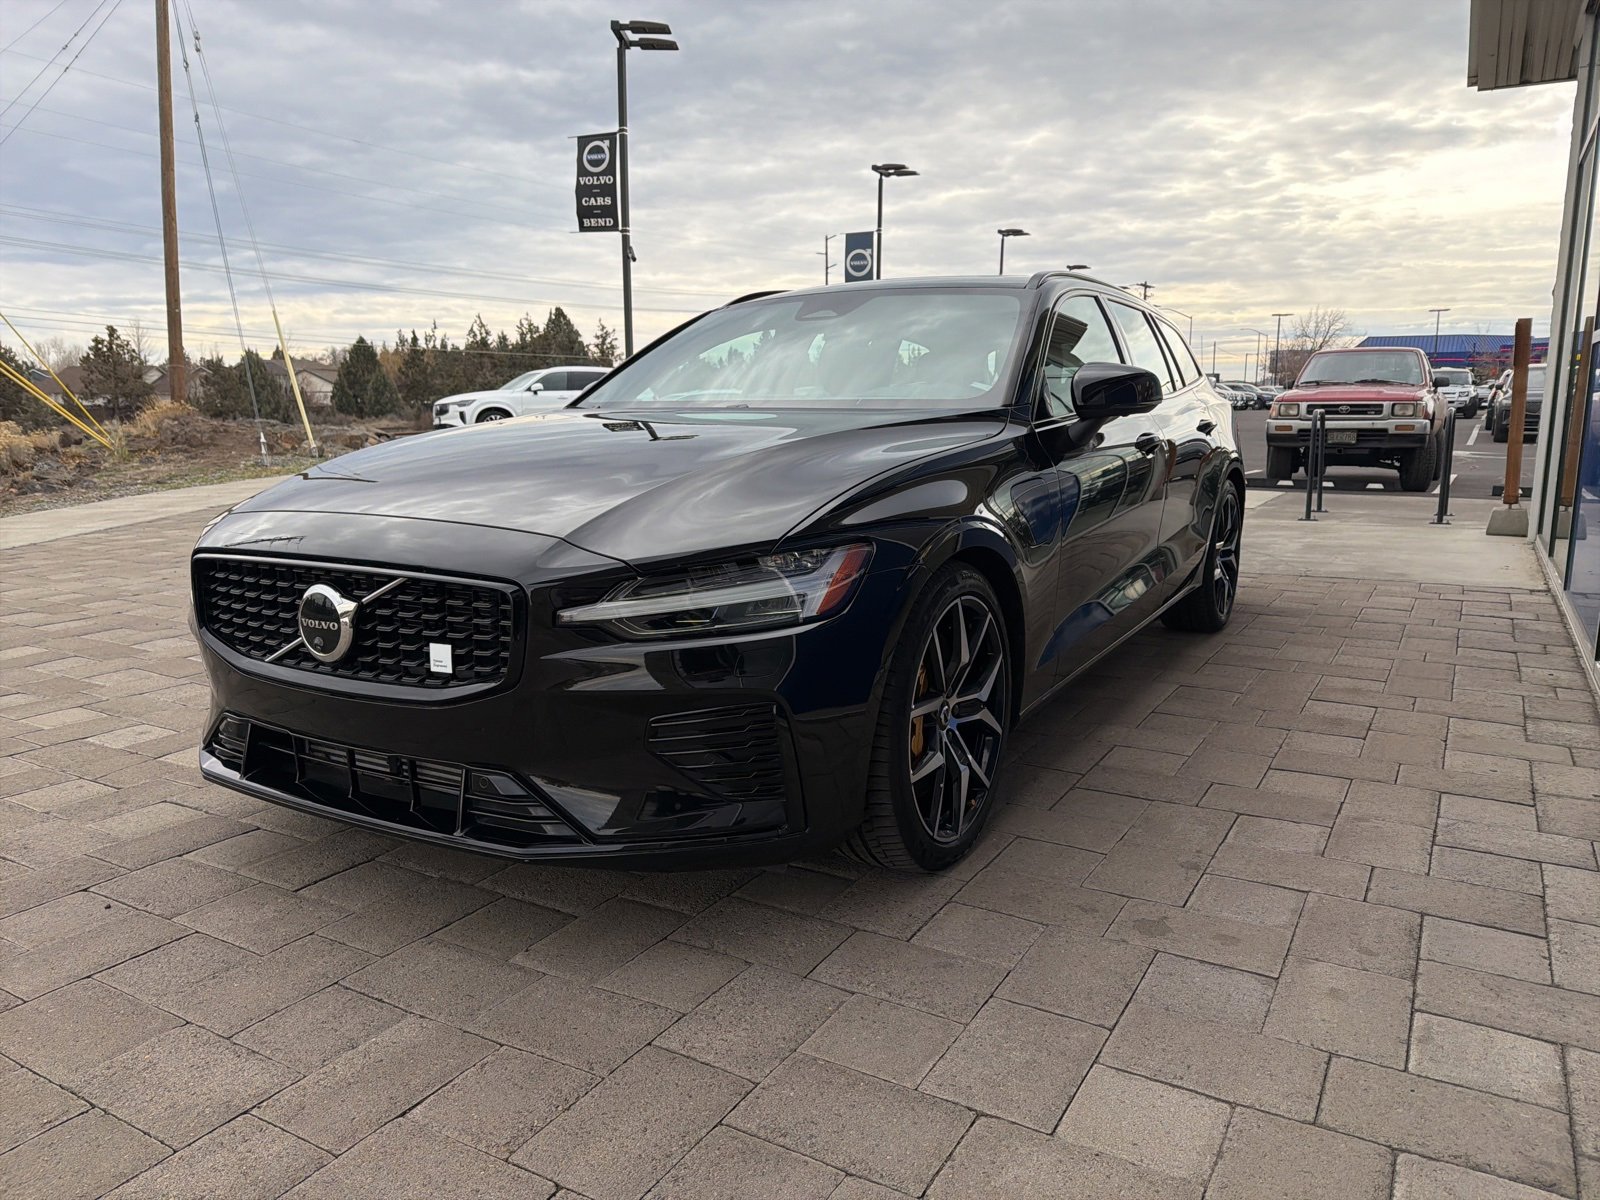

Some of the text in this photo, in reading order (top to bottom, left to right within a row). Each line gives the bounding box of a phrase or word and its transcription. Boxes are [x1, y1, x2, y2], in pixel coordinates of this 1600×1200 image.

[579, 176, 614, 185] VOLVO
[582, 197, 612, 206] CARS
[583, 218, 614, 227] BEND
[302, 618, 339, 631] VOLVO
